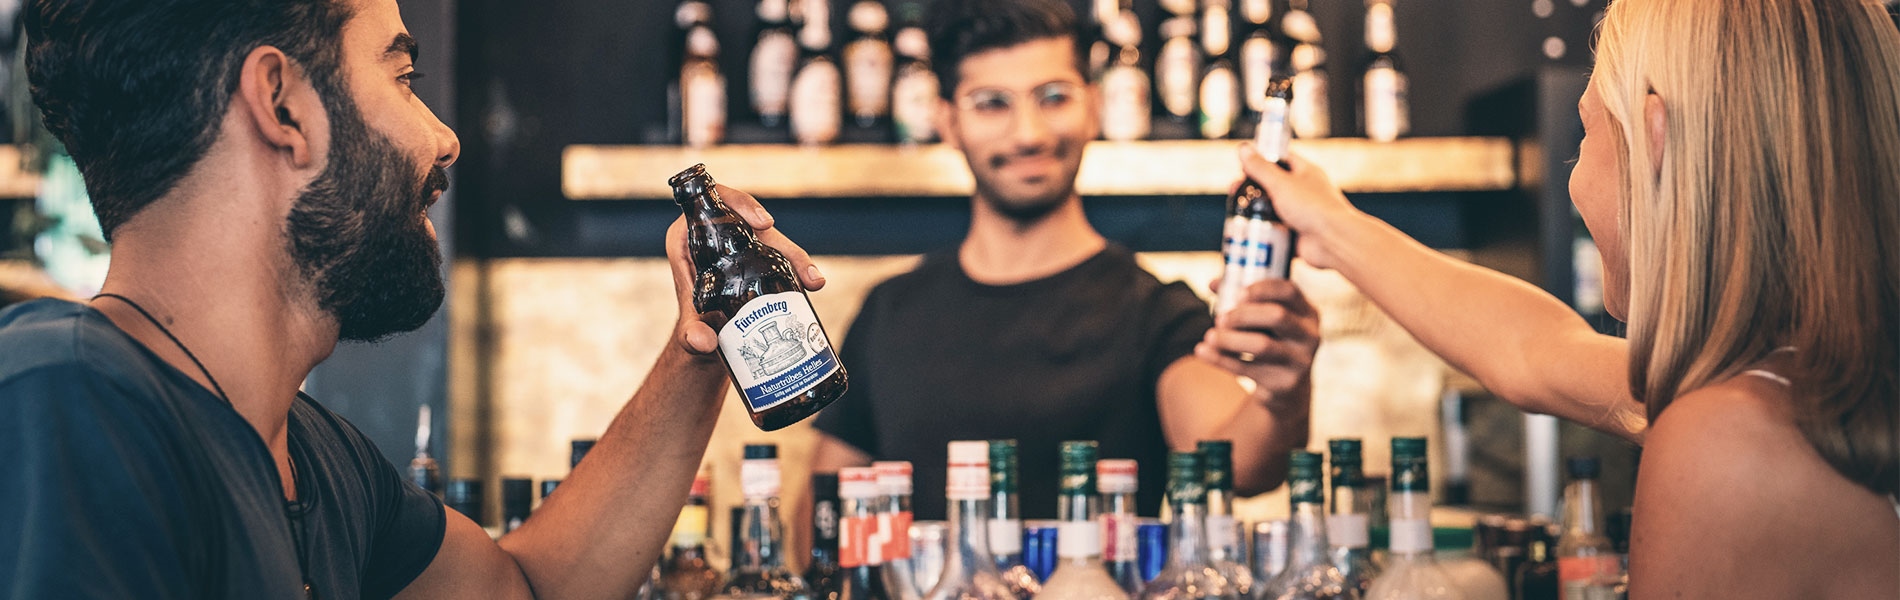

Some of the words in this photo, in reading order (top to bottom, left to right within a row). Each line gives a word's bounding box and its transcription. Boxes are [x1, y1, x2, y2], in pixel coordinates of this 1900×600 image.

[734, 301, 788, 333] Fürstenberg
[760, 371, 803, 395] Naturtrübes
[802, 359, 823, 374] Helles
